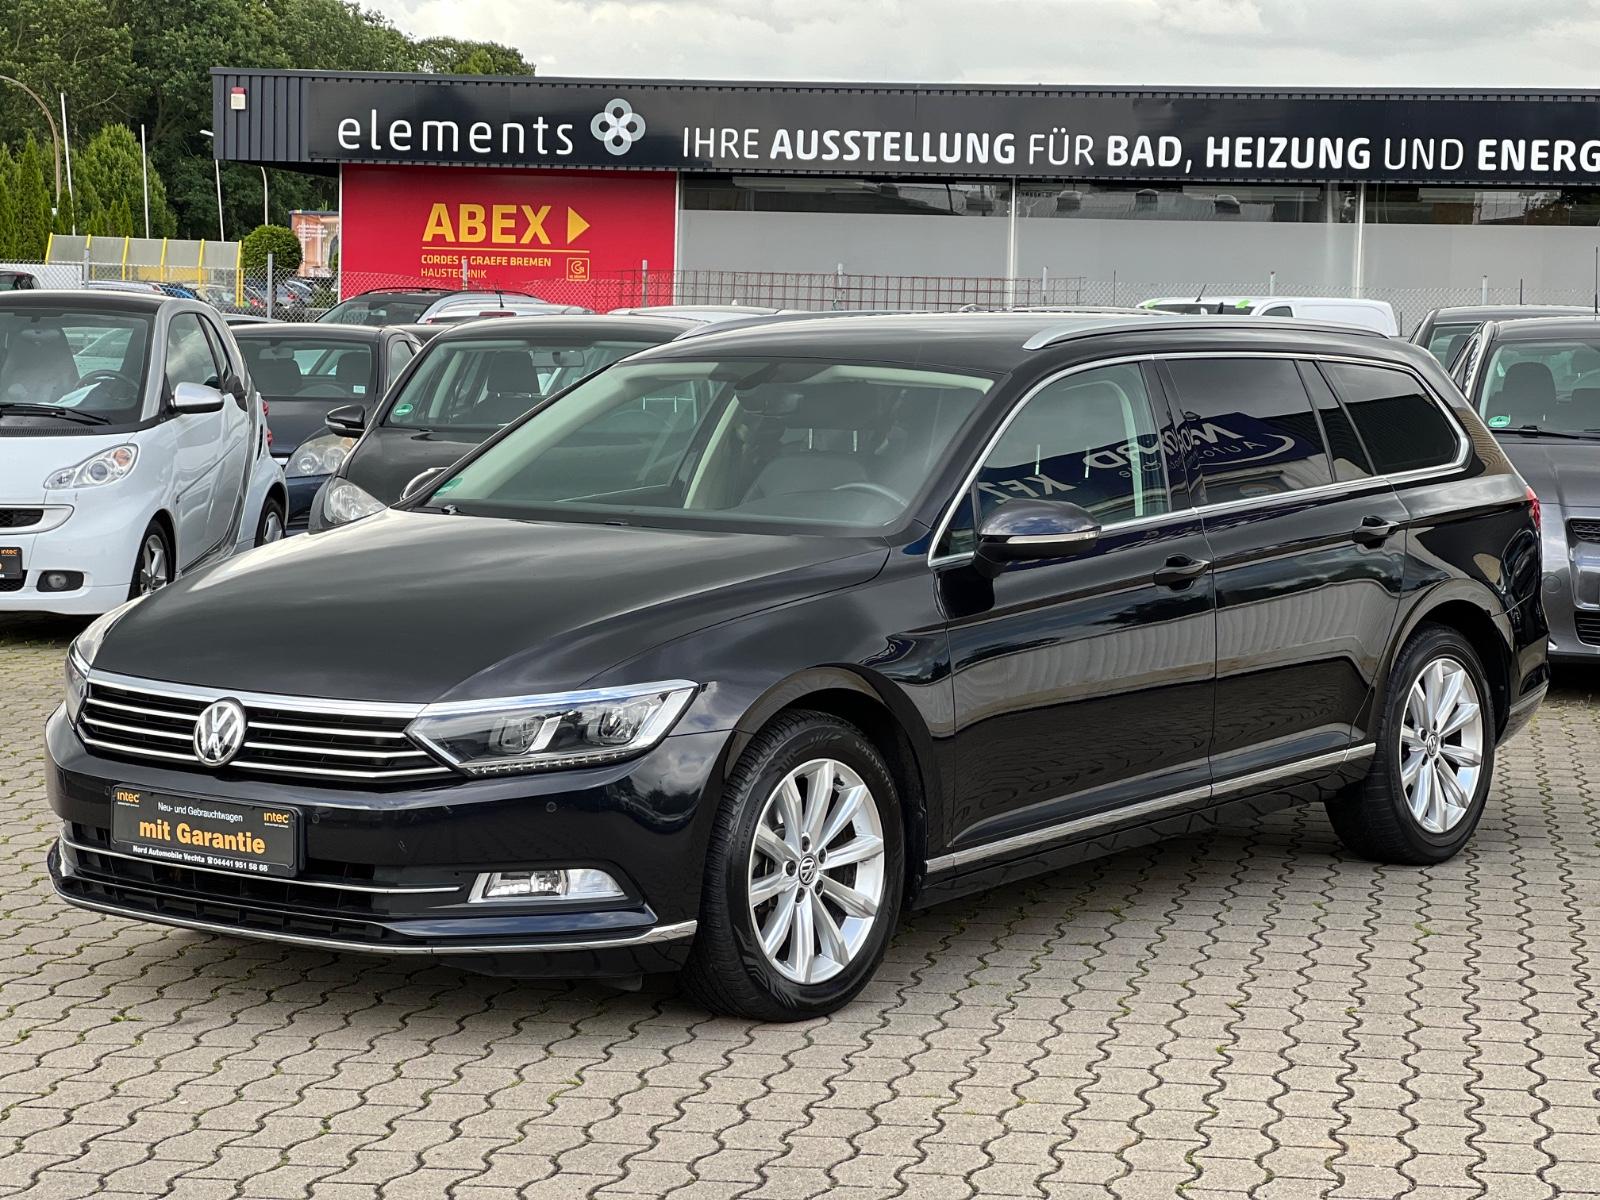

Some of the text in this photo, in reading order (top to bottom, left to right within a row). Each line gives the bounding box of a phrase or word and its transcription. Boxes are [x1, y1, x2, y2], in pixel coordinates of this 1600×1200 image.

[337, 108, 573, 155] elements
[683, 127, 1600, 174] IHRE AUSSTELLUNG FÜR BAD, HEIZUNG UND ENERG
[422, 203, 552, 245] ABEX
[421, 254, 459, 265] CORDES
[470, 255, 508, 266] GRAEFE
[510, 256, 552, 267] BREMEN
[157, 802, 243, 823] Neu- und Gebrauchtwagen
[139, 819, 266, 854] mit Garantie
[132, 845, 148, 854] Nord
[148, 847, 183, 860] Automobile
[183, 852, 206, 863] Vechta
[234, 860, 247, 869] 951
